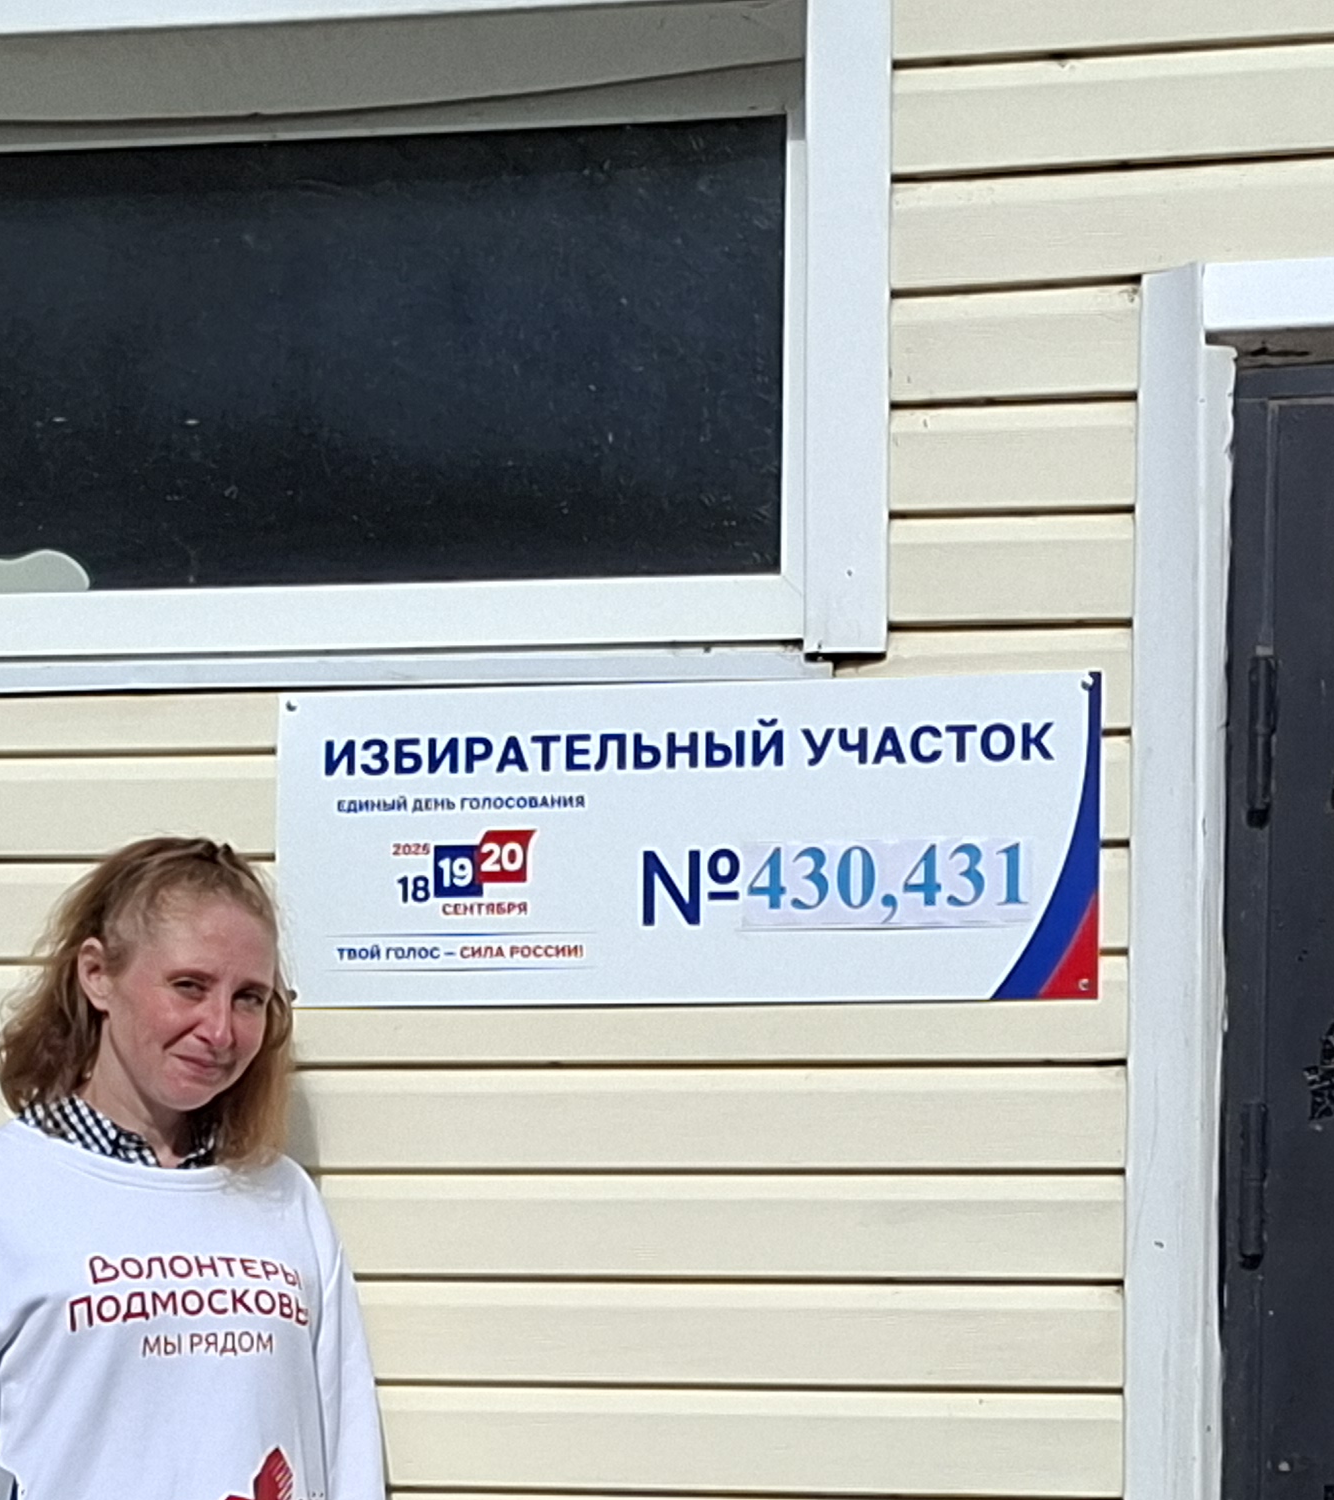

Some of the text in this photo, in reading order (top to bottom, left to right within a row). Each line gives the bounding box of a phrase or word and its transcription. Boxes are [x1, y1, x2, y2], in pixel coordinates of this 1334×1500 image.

[324, 718, 1055, 776] ИЗБИРАТЕЛЬНЫЙ УЧАСТОК
[336, 794, 586, 813] ЕДИНЫЙ ДЕНЬ ГОЛОСОВАНИЯ
[396, 842, 524, 903] 18 19 20
[441, 902, 528, 916] СЕНТЯБРЯ
[336, 945, 381, 961] ТВОЙ
[385, 947, 440, 960] ГОЛОС
[460, 945, 505, 959] СИЛА
[509, 944, 584, 959] РОССИИ!
[89, 1255, 302, 1289] ВОЛОНТЕРЫ
[69, 1288, 309, 1333] ПОДМОСКОВЬ
[142, 1331, 274, 1358] МЫ РЯДОМ
